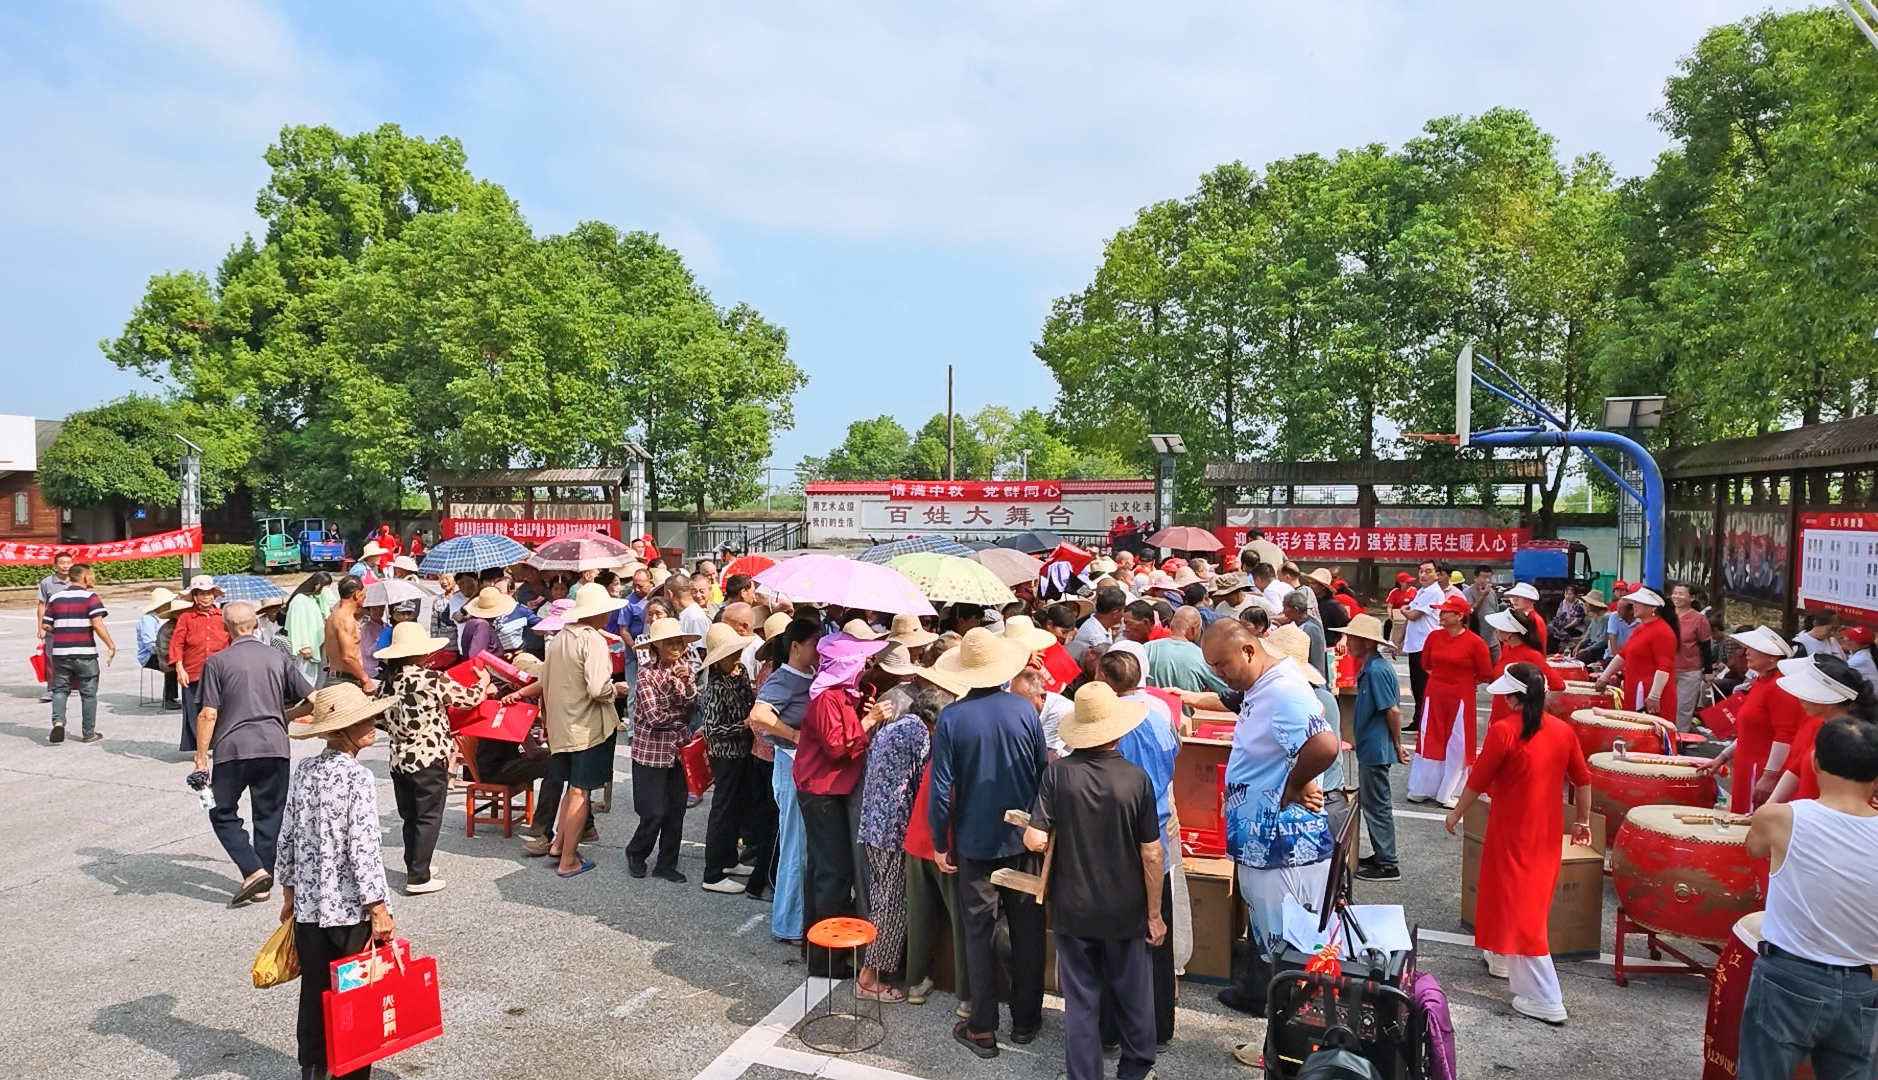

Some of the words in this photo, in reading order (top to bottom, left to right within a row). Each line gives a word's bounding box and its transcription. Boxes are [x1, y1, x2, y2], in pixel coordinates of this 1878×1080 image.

[891, 483, 965, 498] 情满中秋
[983, 485, 1062, 498] 党群同心
[812, 501, 855, 512] 用艺术点缀
[812, 517, 854, 528] 我们的生活
[884, 505, 1075, 527] 百姓大舞台
[1234, 531, 1361, 552] 迎话乡音聚合力
[1367, 532, 1507, 553] 强党建惠民生暖人心
